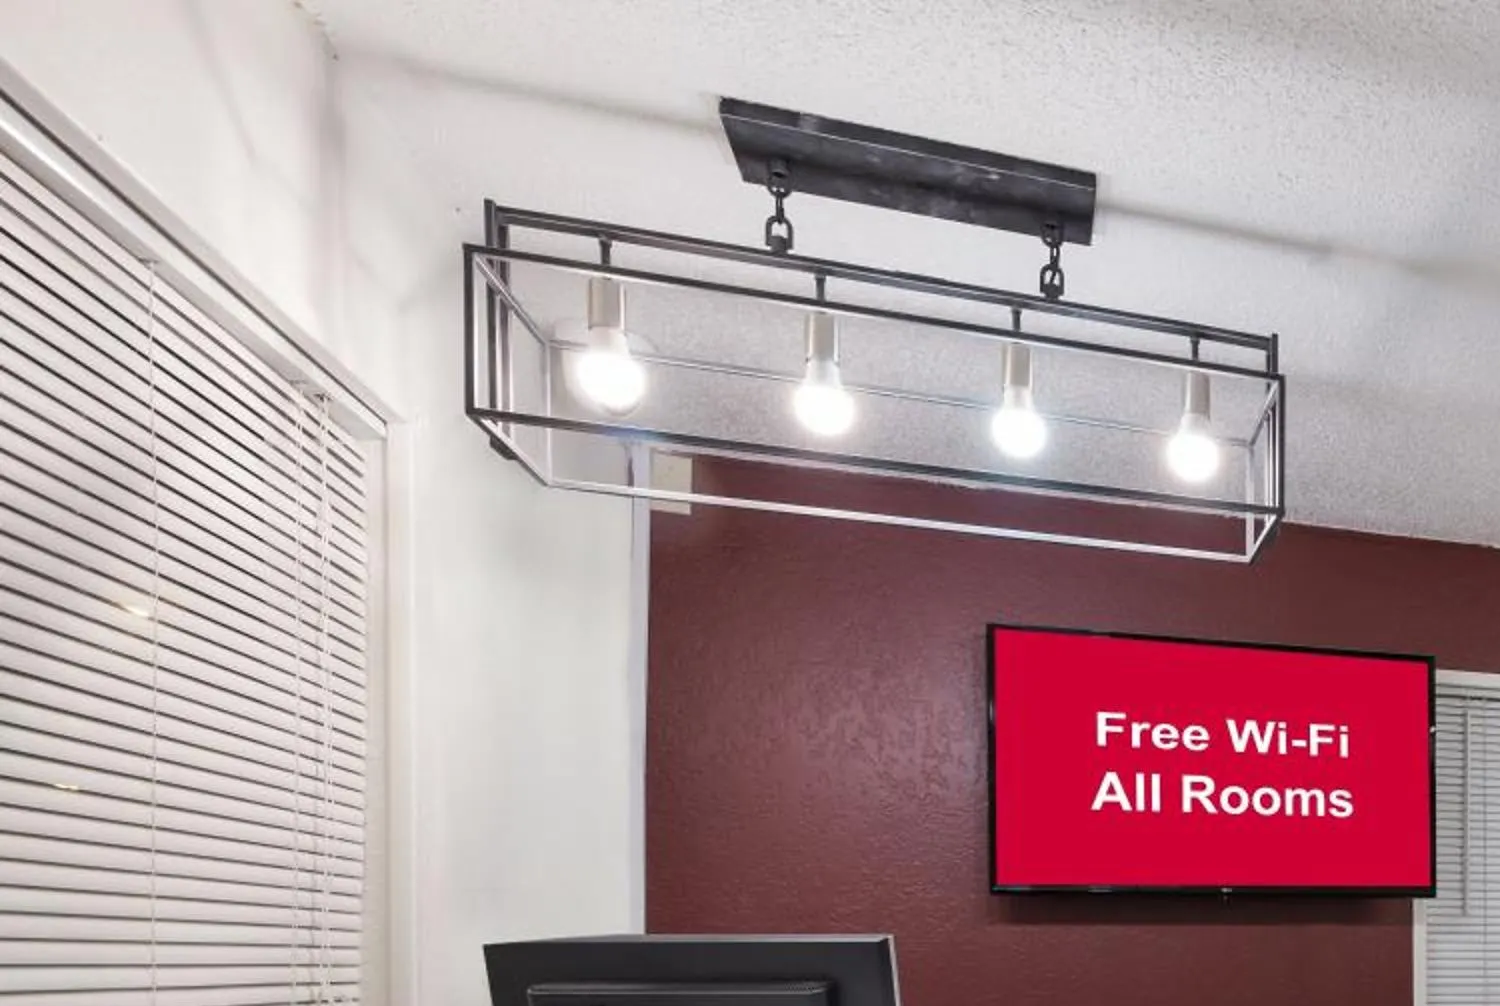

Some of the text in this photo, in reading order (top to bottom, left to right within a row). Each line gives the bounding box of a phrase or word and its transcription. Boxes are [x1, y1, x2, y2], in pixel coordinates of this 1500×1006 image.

[1096, 711, 1349, 758] Free Wi-Fi
[1091, 771, 1354, 818] All Rooms
